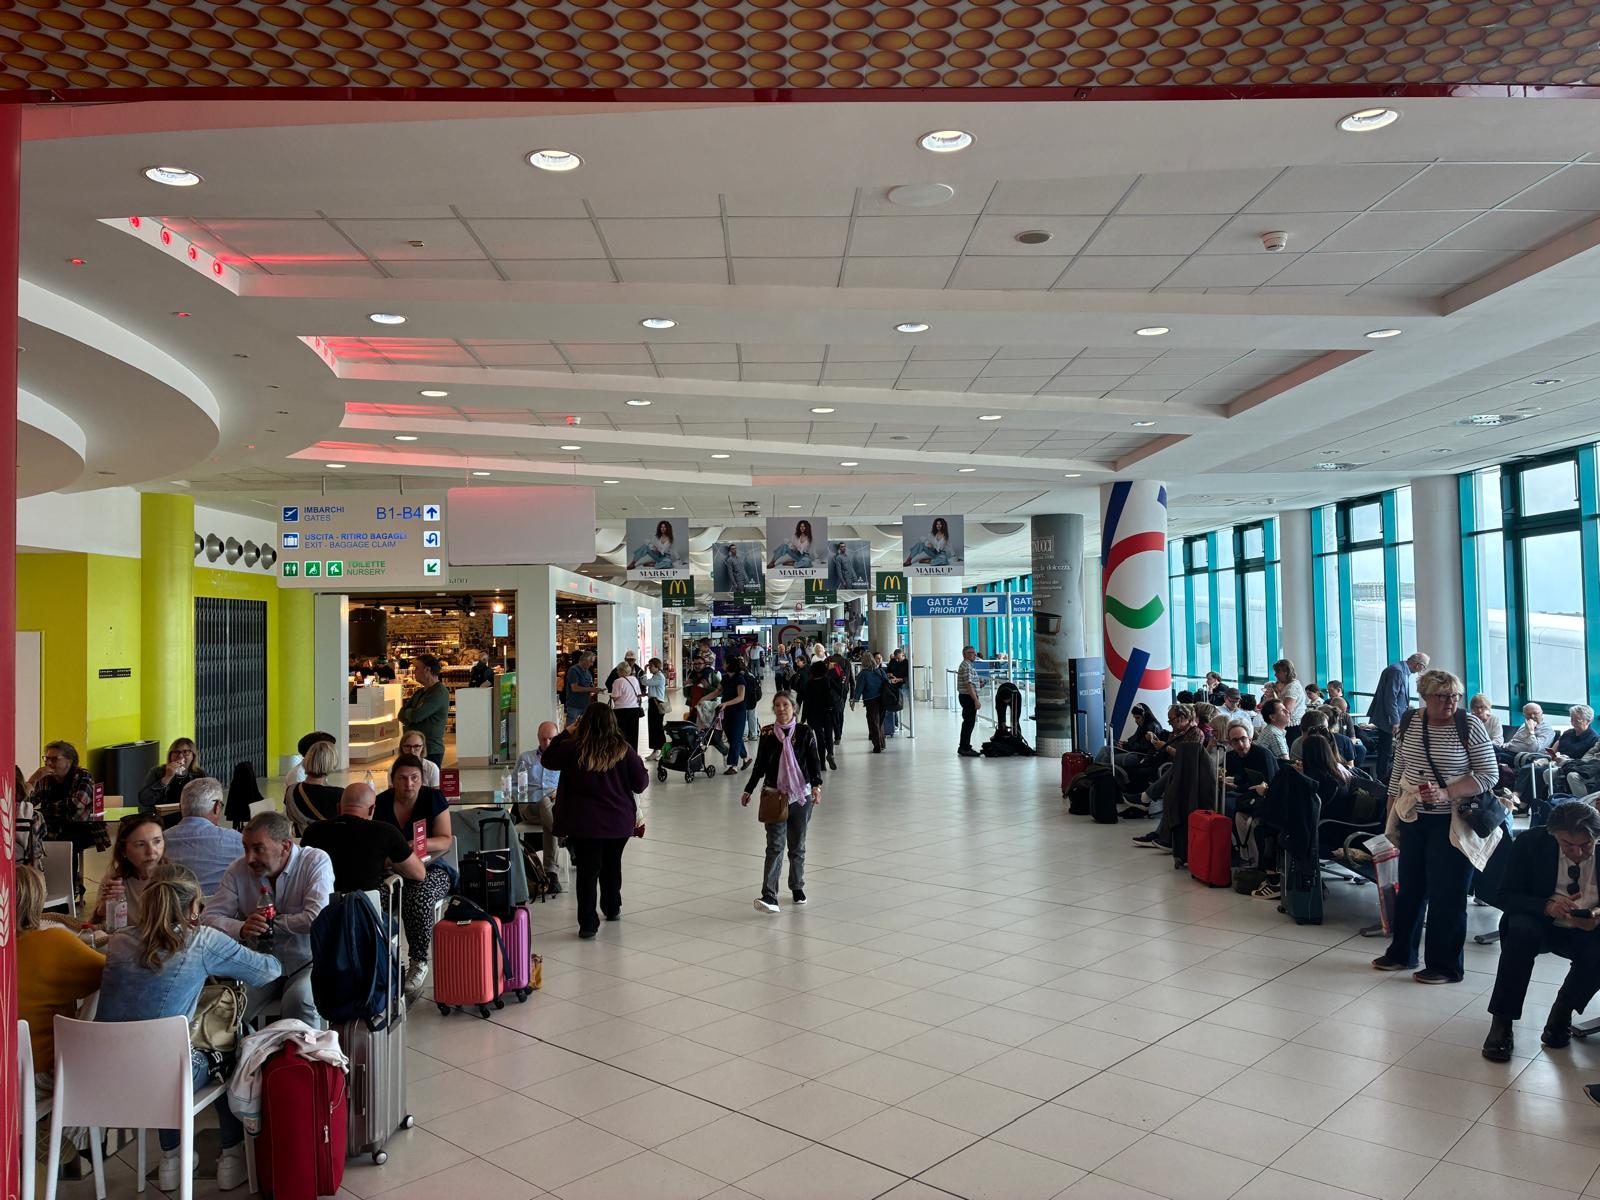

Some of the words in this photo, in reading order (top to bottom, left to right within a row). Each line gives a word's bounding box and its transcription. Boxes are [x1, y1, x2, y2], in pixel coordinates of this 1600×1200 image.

[376, 506, 422, 520] B1-B4
[370, 532, 407, 540] BAGAGLI
[926, 597, 953, 606] GATE
[956, 597, 969, 606] A2
[1013, 597, 1032, 605] GAT
[929, 606, 968, 614] PRIORITY
